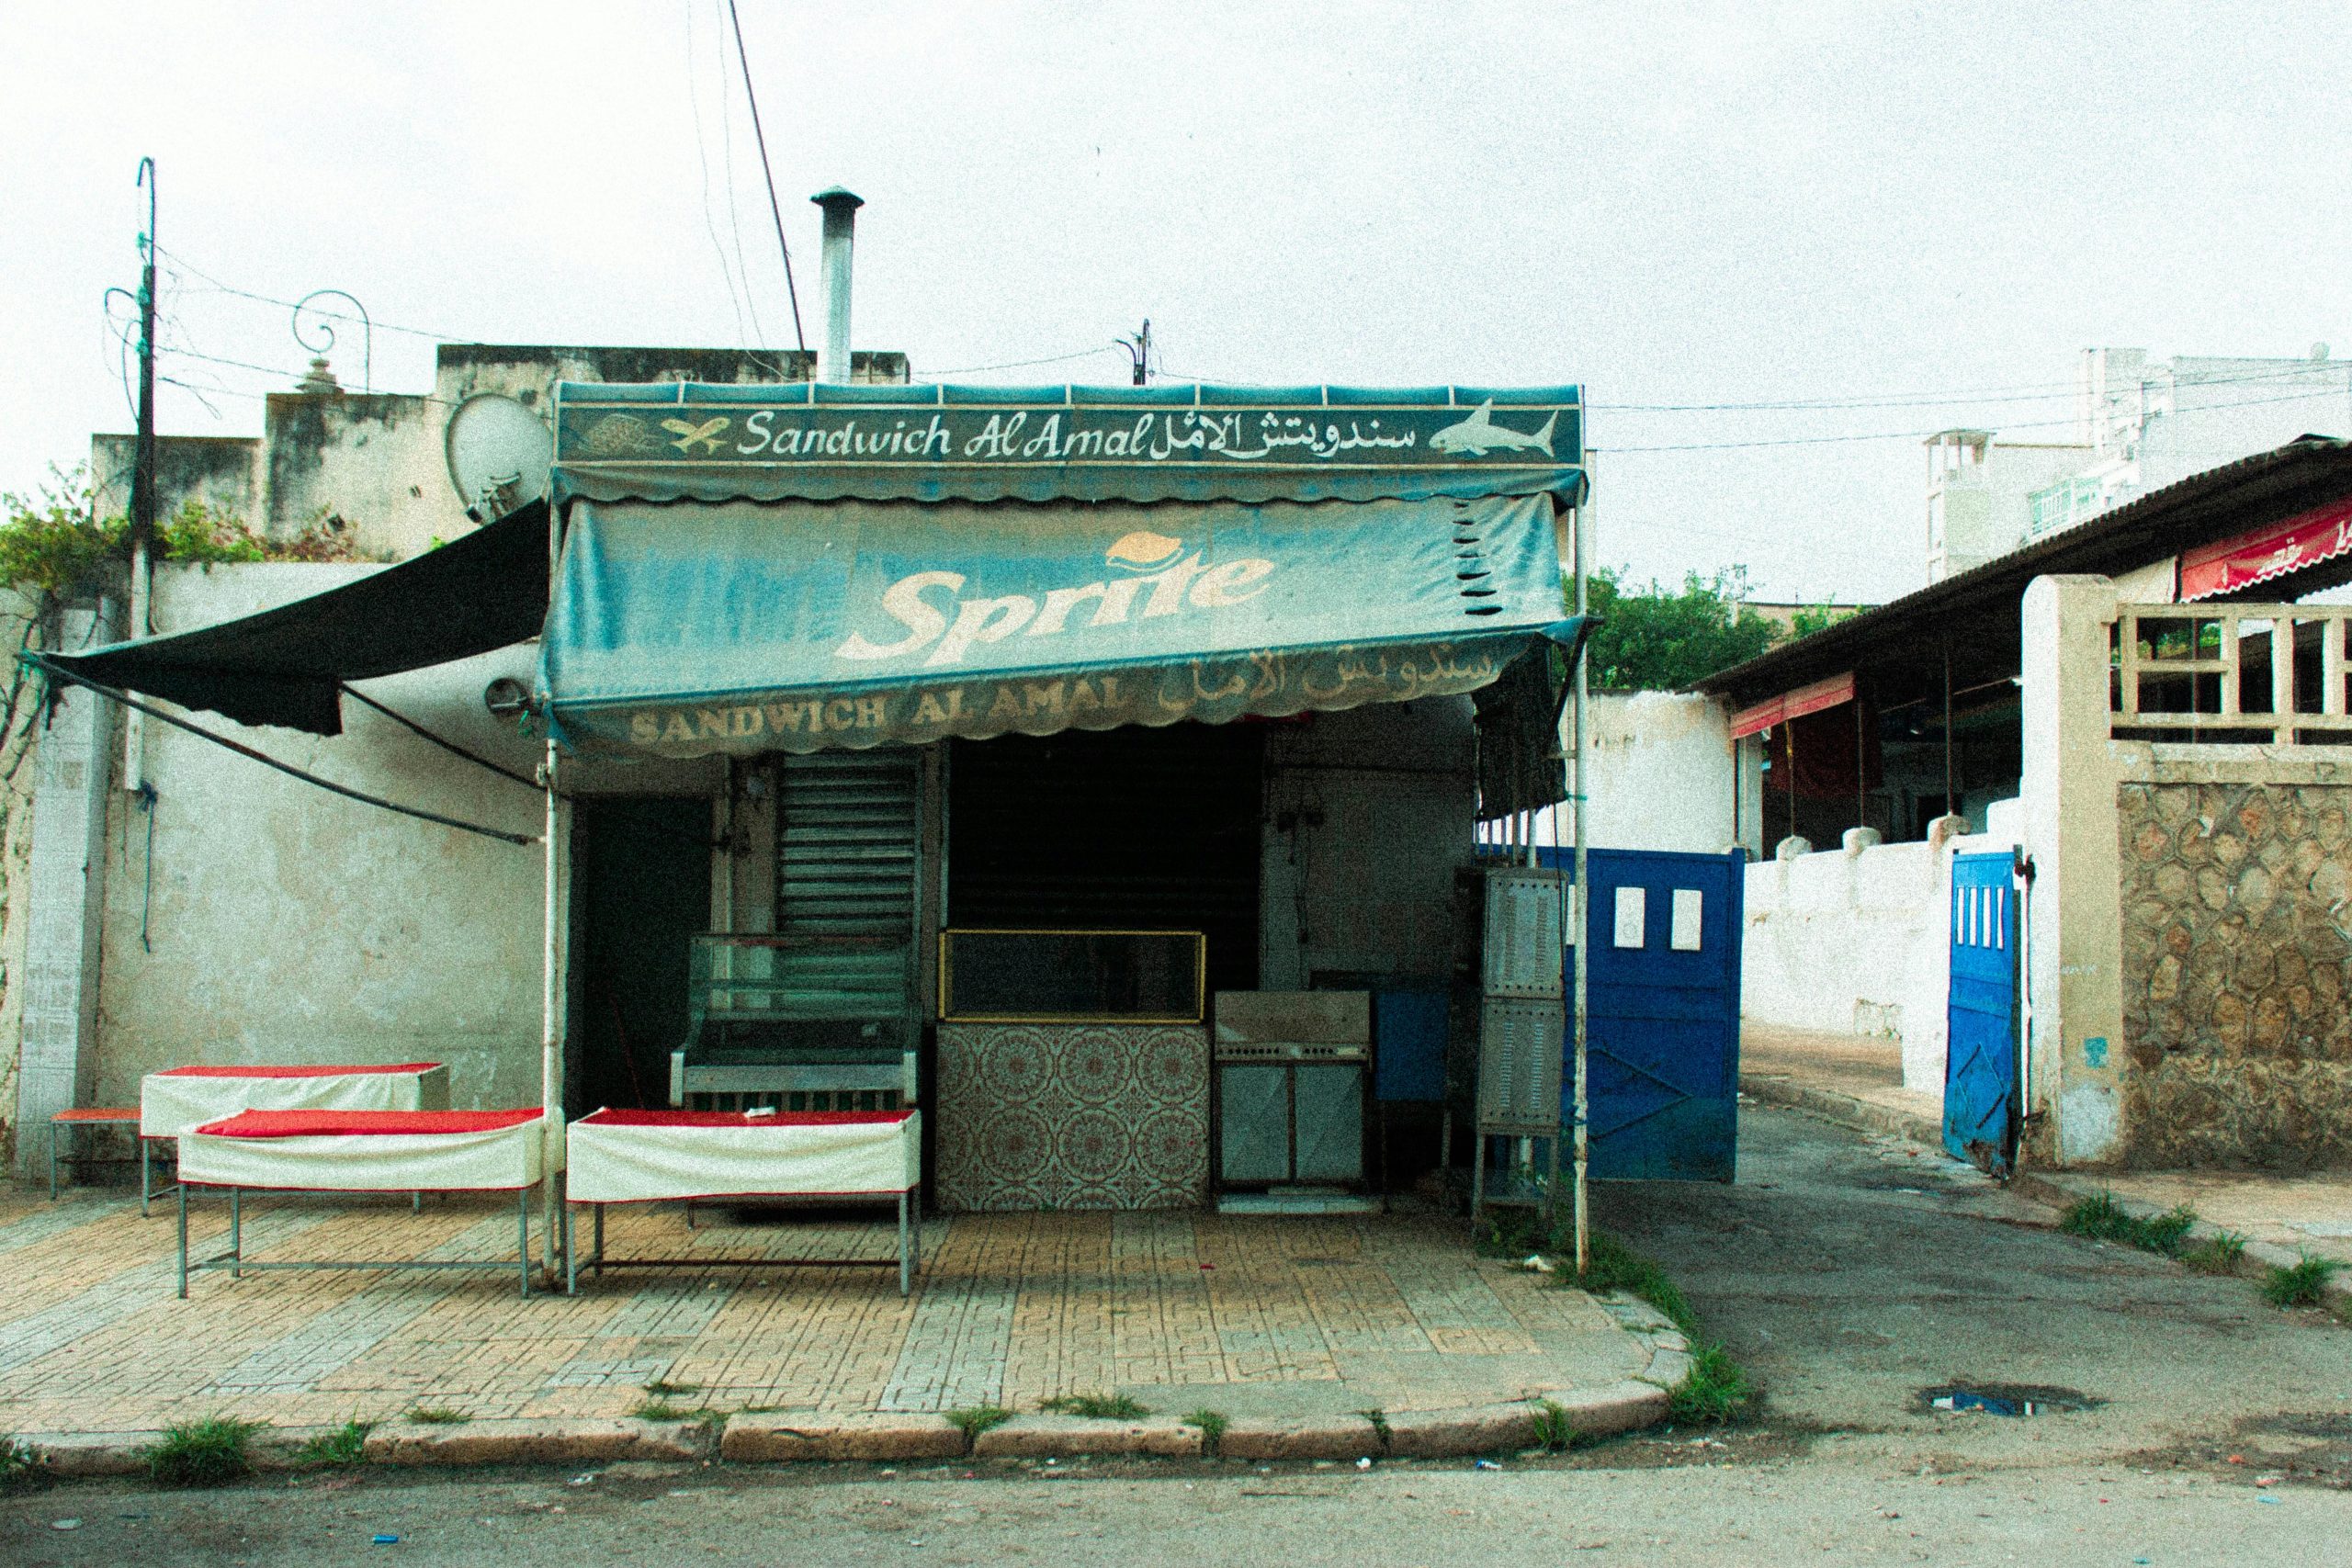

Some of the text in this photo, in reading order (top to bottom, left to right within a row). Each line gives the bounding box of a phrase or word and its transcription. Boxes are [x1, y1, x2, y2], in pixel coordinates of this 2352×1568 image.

[737, 411, 1155, 458] Sandwich Al Amal
[1219, 412, 1416, 459] سندويتش
[834, 532, 1276, 668] Sprite
[630, 677, 1133, 745] SANDWICH AL AMAL
